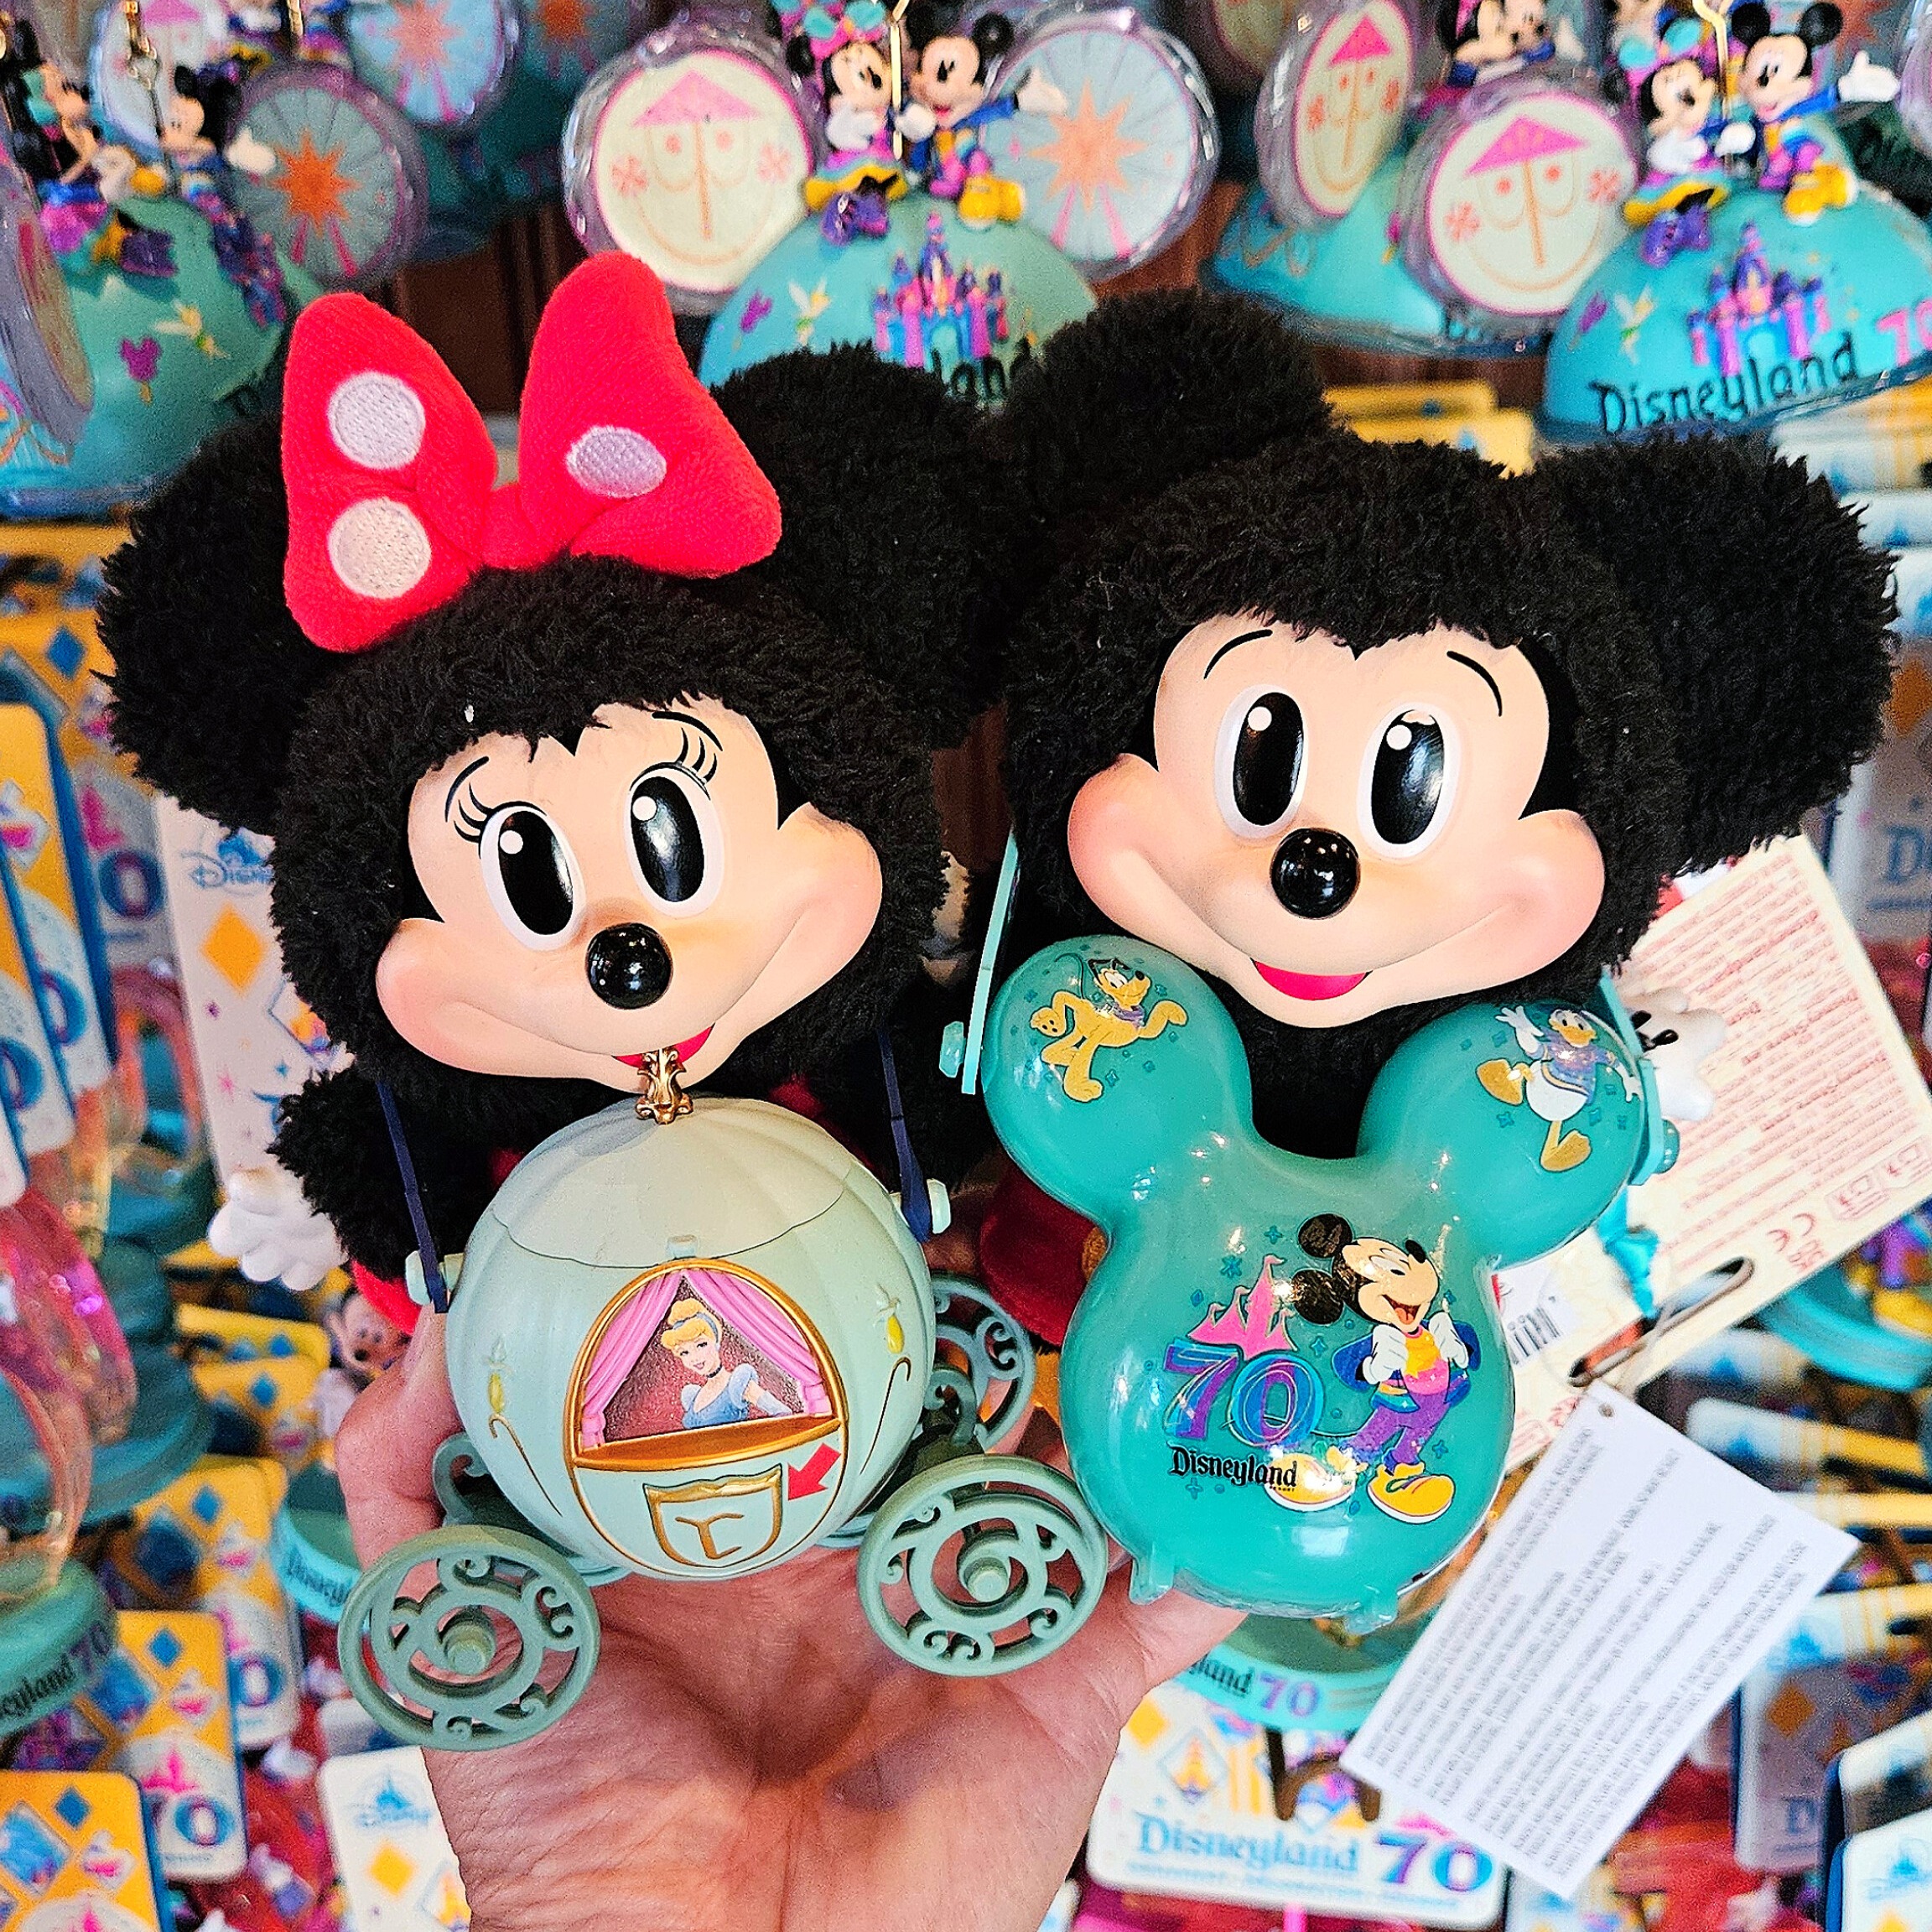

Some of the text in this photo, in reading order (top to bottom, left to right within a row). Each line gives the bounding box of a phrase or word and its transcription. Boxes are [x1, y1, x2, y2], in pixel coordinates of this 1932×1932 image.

[1589, 330, 1858, 435] Disneyland
[1163, 1340, 1324, 1449] 70
[1167, 1441, 1297, 1487] Disneyland
[1259, 1670, 1321, 1717] 70
[1134, 1811, 1359, 1872] Disneyland
[1375, 1830, 1494, 1893] 70
